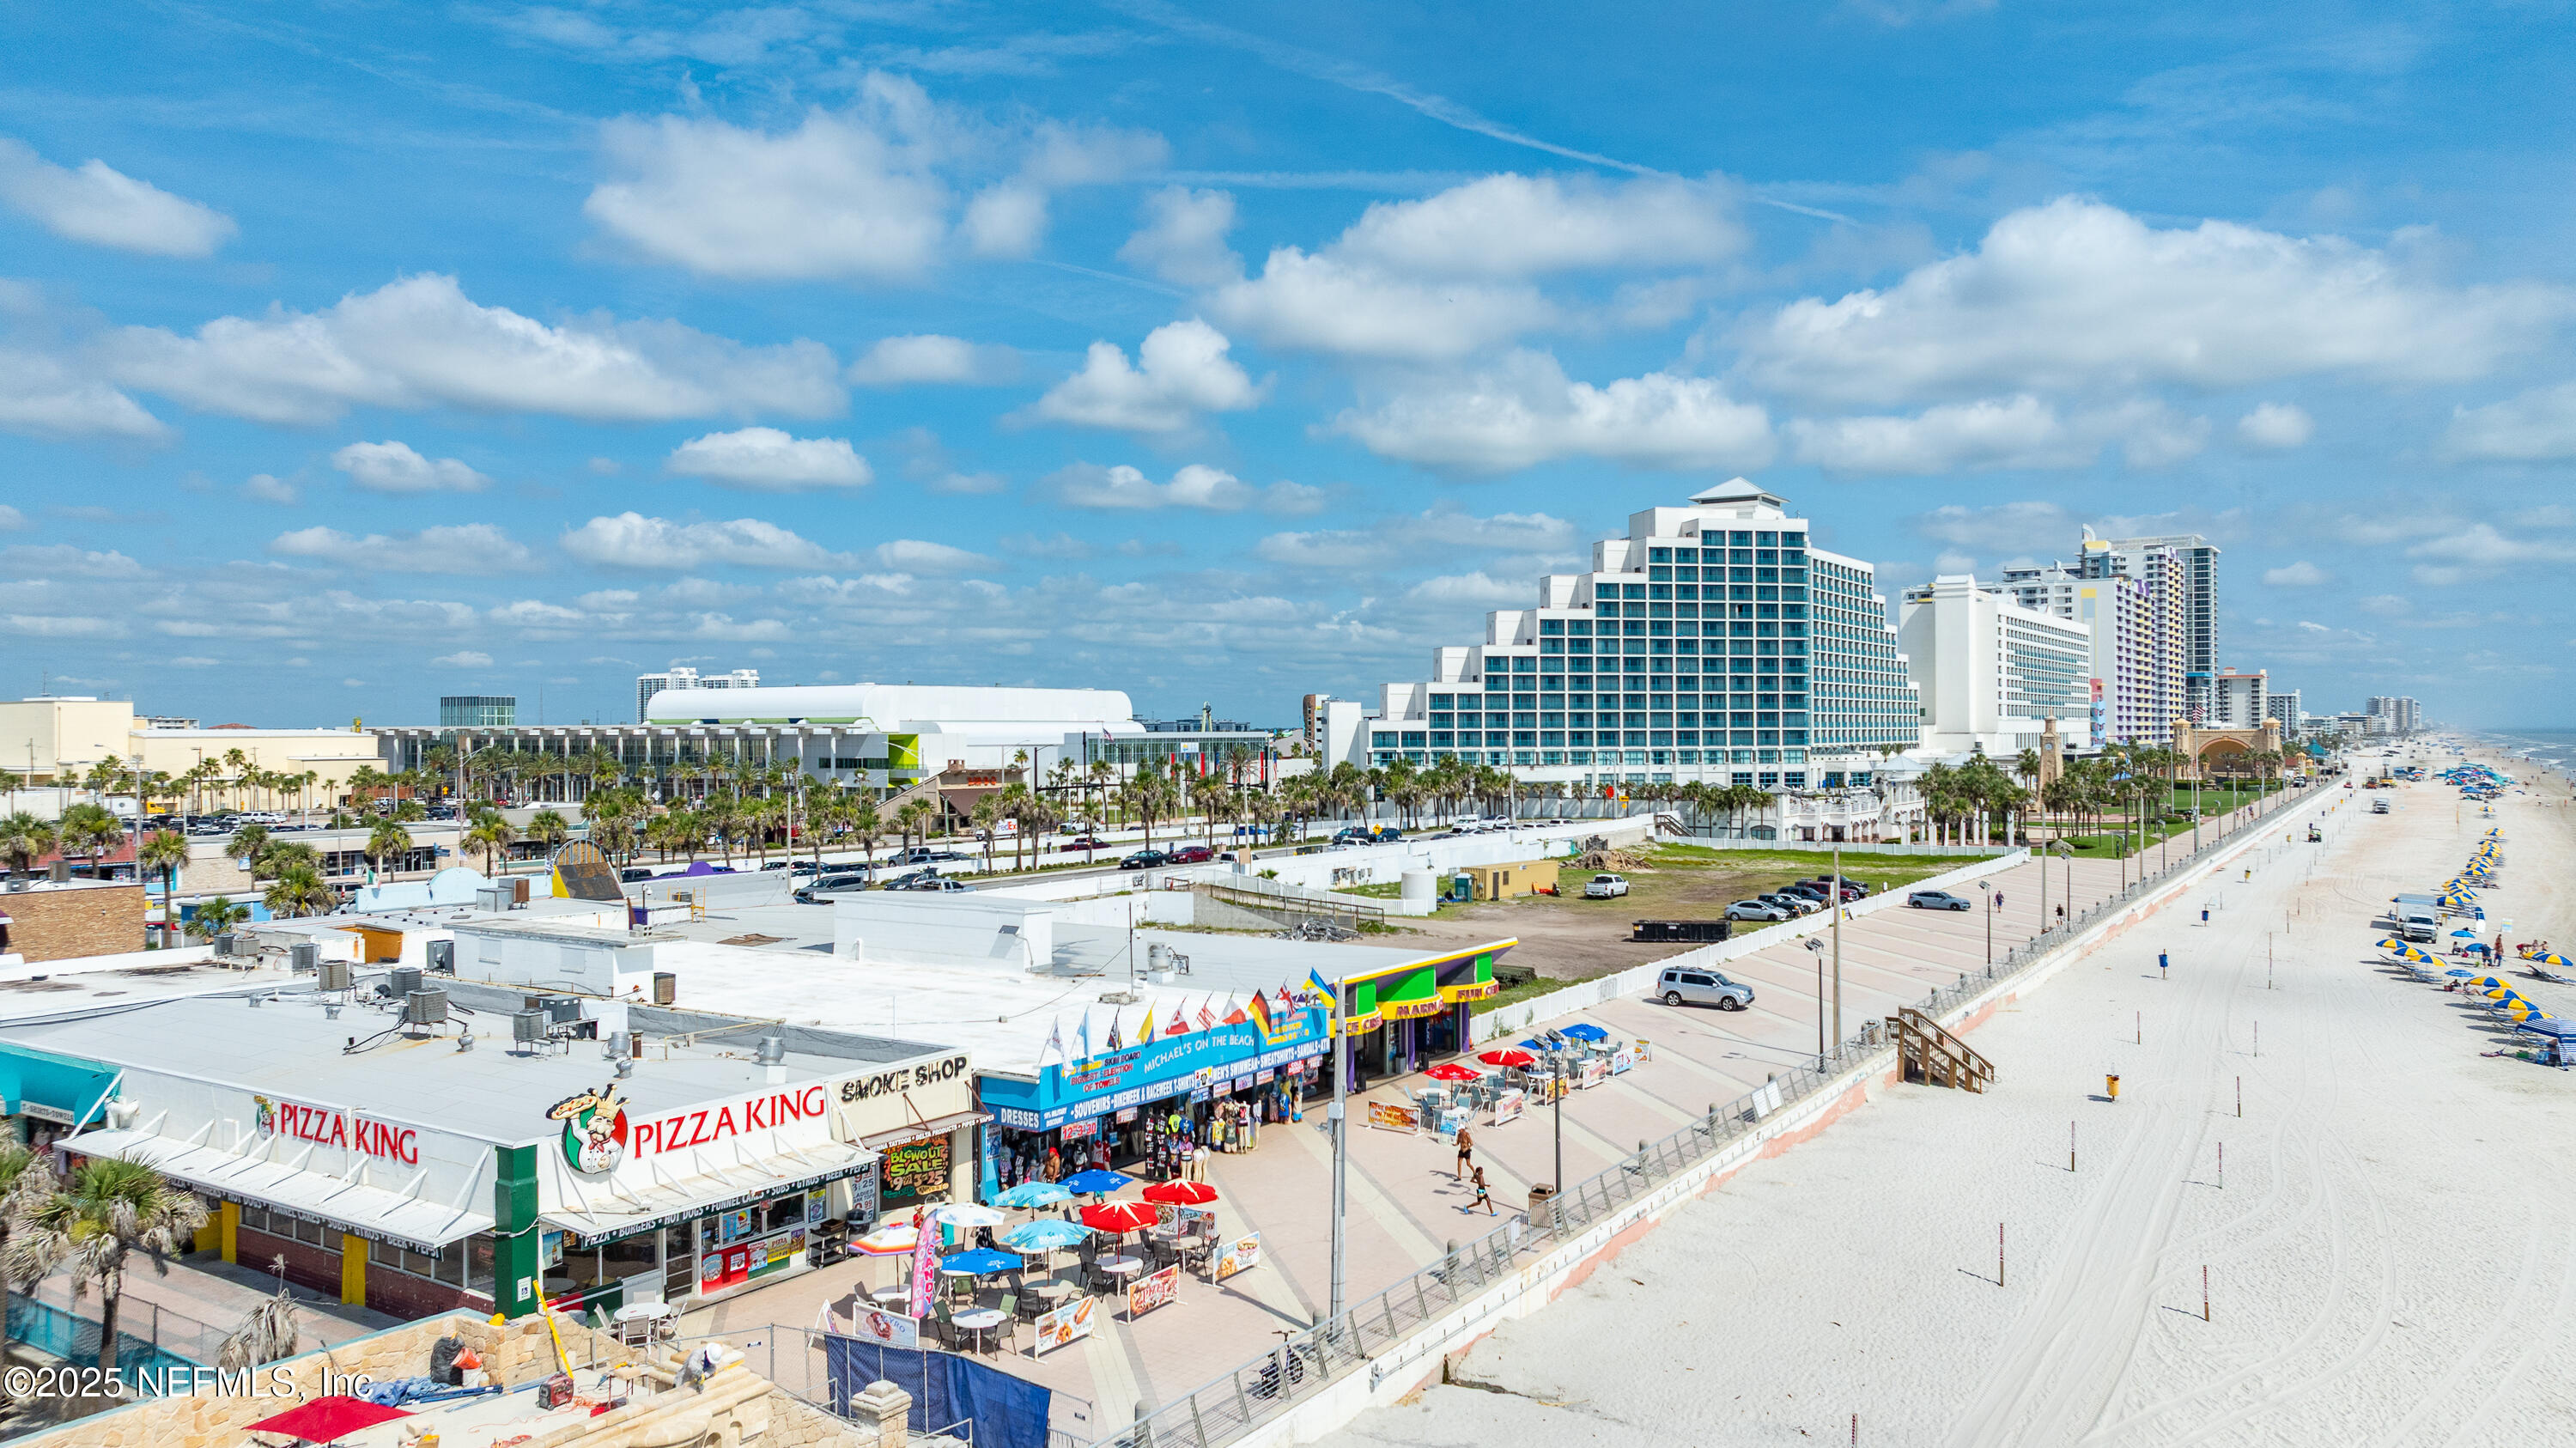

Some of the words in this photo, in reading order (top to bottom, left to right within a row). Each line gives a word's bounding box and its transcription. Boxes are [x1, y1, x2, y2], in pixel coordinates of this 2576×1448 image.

[1457, 988, 1482, 1000] FUN
[1121, 1050, 1141, 1062] BOARD
[1144, 1042, 1192, 1074] MICHAEL'S
[1194, 1038, 1209, 1052] ON
[1212, 1035, 1228, 1047] THE
[1229, 1034, 1255, 1046] BEACH
[1213, 1064, 1229, 1082] MEN'S
[1230, 1056, 1258, 1077] SWIMWEAR
[1260, 1046, 1295, 1068] SWEATSHIRTS
[1297, 1039, 1318, 1056] SANDALS
[841, 1068, 910, 1103] SMOKE
[914, 1056, 968, 1086] SHOP
[1071, 1072, 1098, 1086] BIGGEST
[1084, 1084, 1093, 1093] OF
[1094, 1076, 1121, 1090] TOWELS
[1074, 1095, 1110, 1120] SOUVENIRS
[1114, 1088, 1141, 1109] BIKEWEEK
[1146, 1080, 1173, 1099] RACEWEEK
[1174, 1074, 1195, 1092] T-SHIRTS
[280, 1103, 347, 1148] PIZZA
[355, 1118, 418, 1165] KING
[634, 1106, 738, 1160] PIZZA
[745, 1086, 825, 1134] KING
[889, 1135, 912, 1149] TATTOOS
[915, 1131, 931, 1141] DELTA
[932, 1124, 957, 1136] PRODUCTS
[962, 1119, 975, 1129] PIPES
[980, 1114, 995, 1123] VAPES
[1000, 1108, 1040, 1129] DRESSES
[890, 1146, 945, 1164] BLOWOUT
[890, 1159, 944, 1177] SALE
[585, 1232, 611, 1248] PIZZA
[619, 1219, 657, 1238] BURGERS
[665, 1212, 679, 1226] HOT
[683, 1206, 703, 1220] DOGS
[711, 1198, 741, 1213] FUNNEL
[772, 1184, 790, 1196] SUBS
[797, 1176, 819, 1189] GYROS
[826, 1170, 843, 1181] BEER
[849, 1163, 869, 1175] PEPSI
[1180, 1208, 1199, 1220] Pizza
[327, 1219, 347, 1232] SUBS
[354, 1226, 380, 1241] GYROS
[386, 1235, 408, 1250] BEER
[415, 1244, 440, 1258] PEPSI
[771, 1238, 787, 1248] PIZZA
[914, 1234, 927, 1313] COTTON
[924, 1244, 935, 1305] CANDY
[882, 1312, 907, 1334] GYRO
